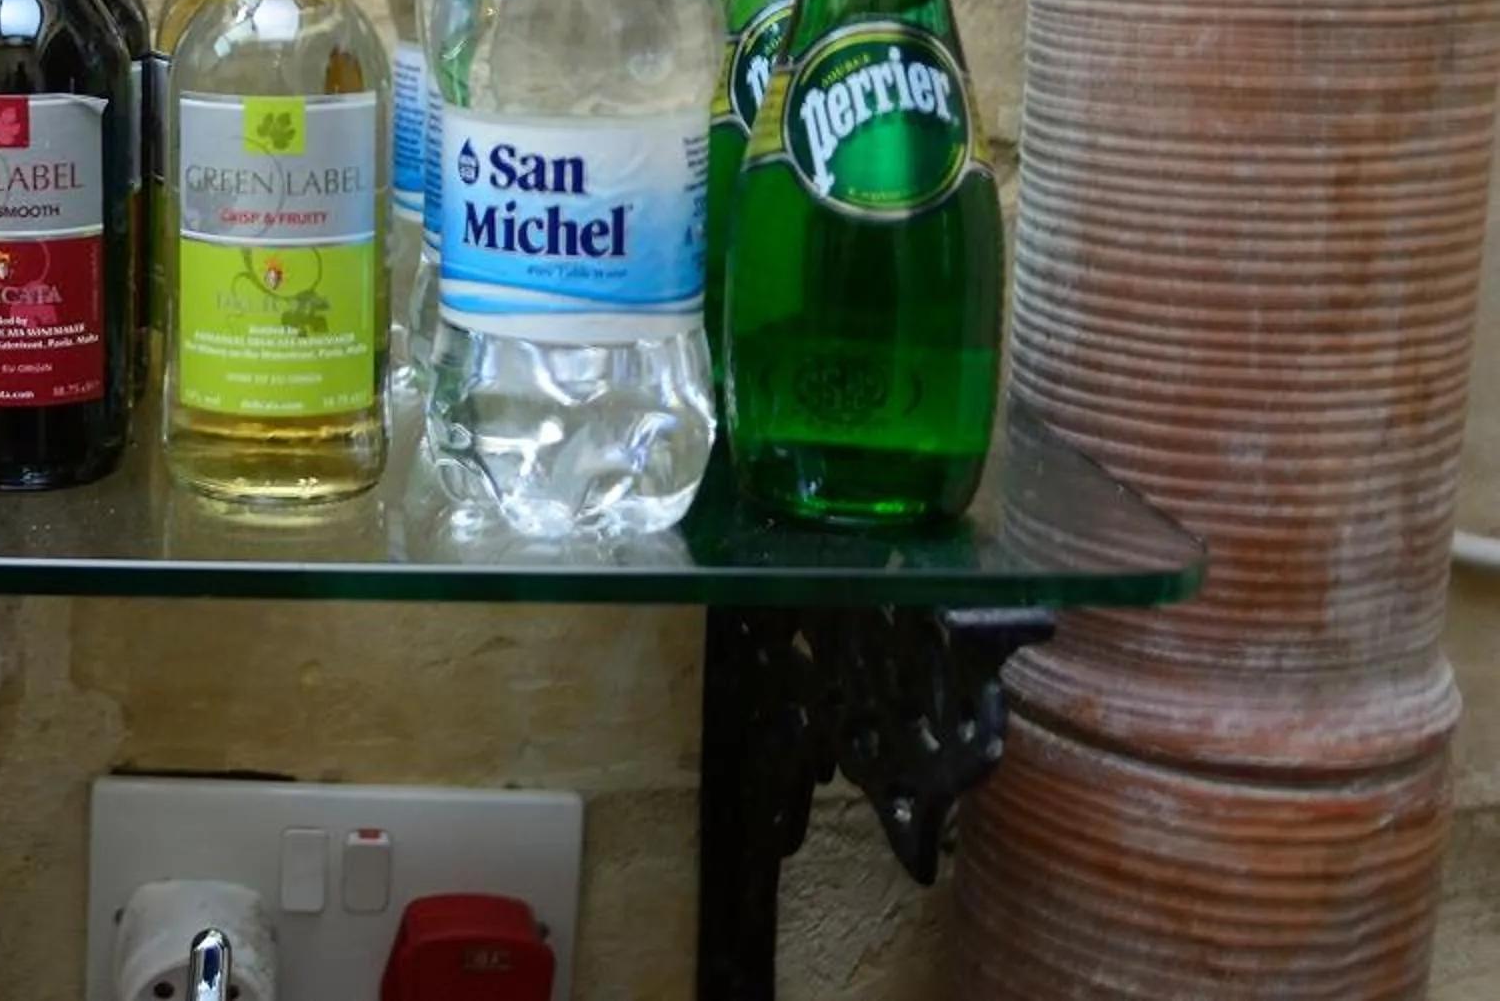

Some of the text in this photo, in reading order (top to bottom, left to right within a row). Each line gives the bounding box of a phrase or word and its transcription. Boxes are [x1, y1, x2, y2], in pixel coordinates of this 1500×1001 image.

[185, 165, 366, 196] GREEN LABEL
[489, 144, 587, 194] San
[220, 209, 260, 224] CRISP
[279, 211, 329, 225] FRUITY
[463, 201, 626, 257] Michel
